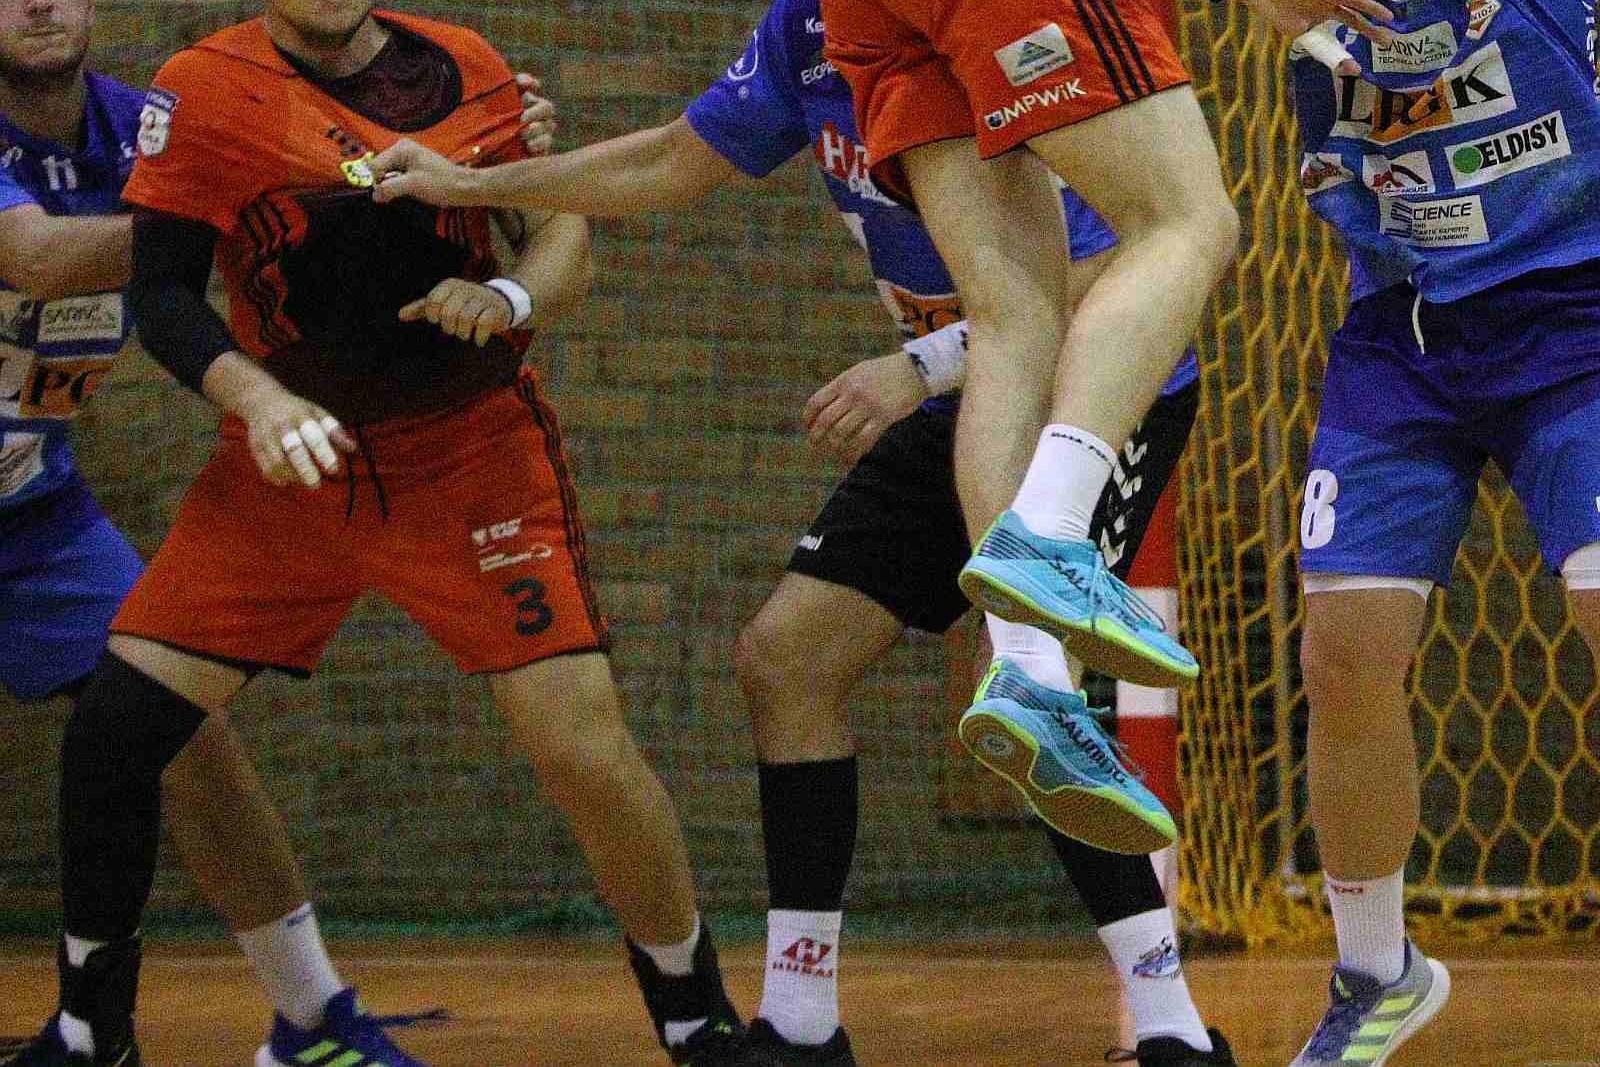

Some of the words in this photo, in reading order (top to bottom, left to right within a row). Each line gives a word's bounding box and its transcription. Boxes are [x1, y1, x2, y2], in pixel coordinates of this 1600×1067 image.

[1479, 116, 1558, 170] ELDISY
[1300, 469, 1338, 550] 8
[503, 576, 553, 636] 3
